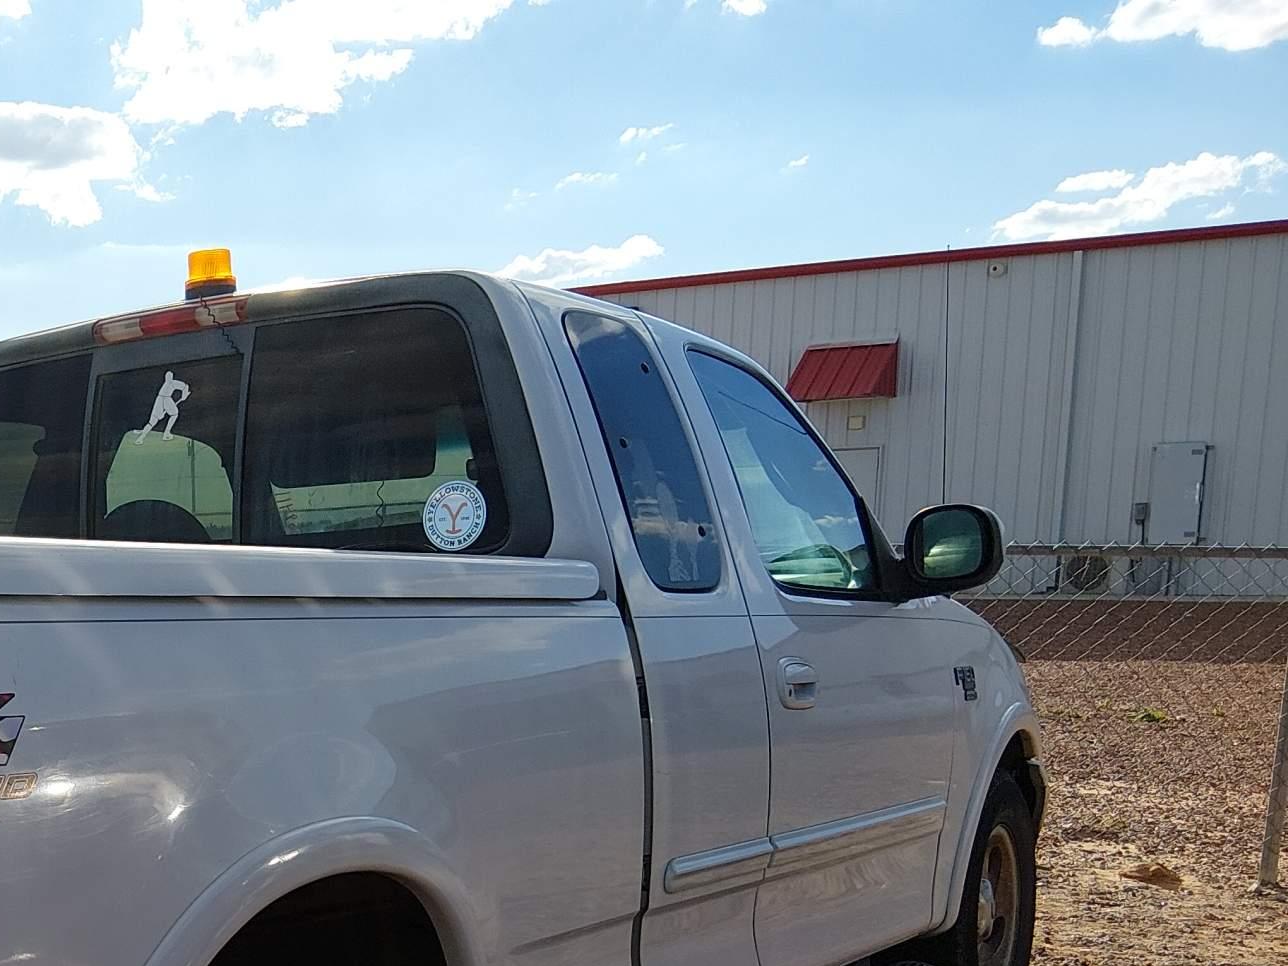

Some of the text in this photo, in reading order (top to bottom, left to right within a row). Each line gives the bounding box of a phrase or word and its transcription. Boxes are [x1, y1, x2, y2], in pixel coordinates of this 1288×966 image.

[427, 486, 481, 515] YELLOWSTONE
[428, 522, 481, 547] DUTTON RANCH
